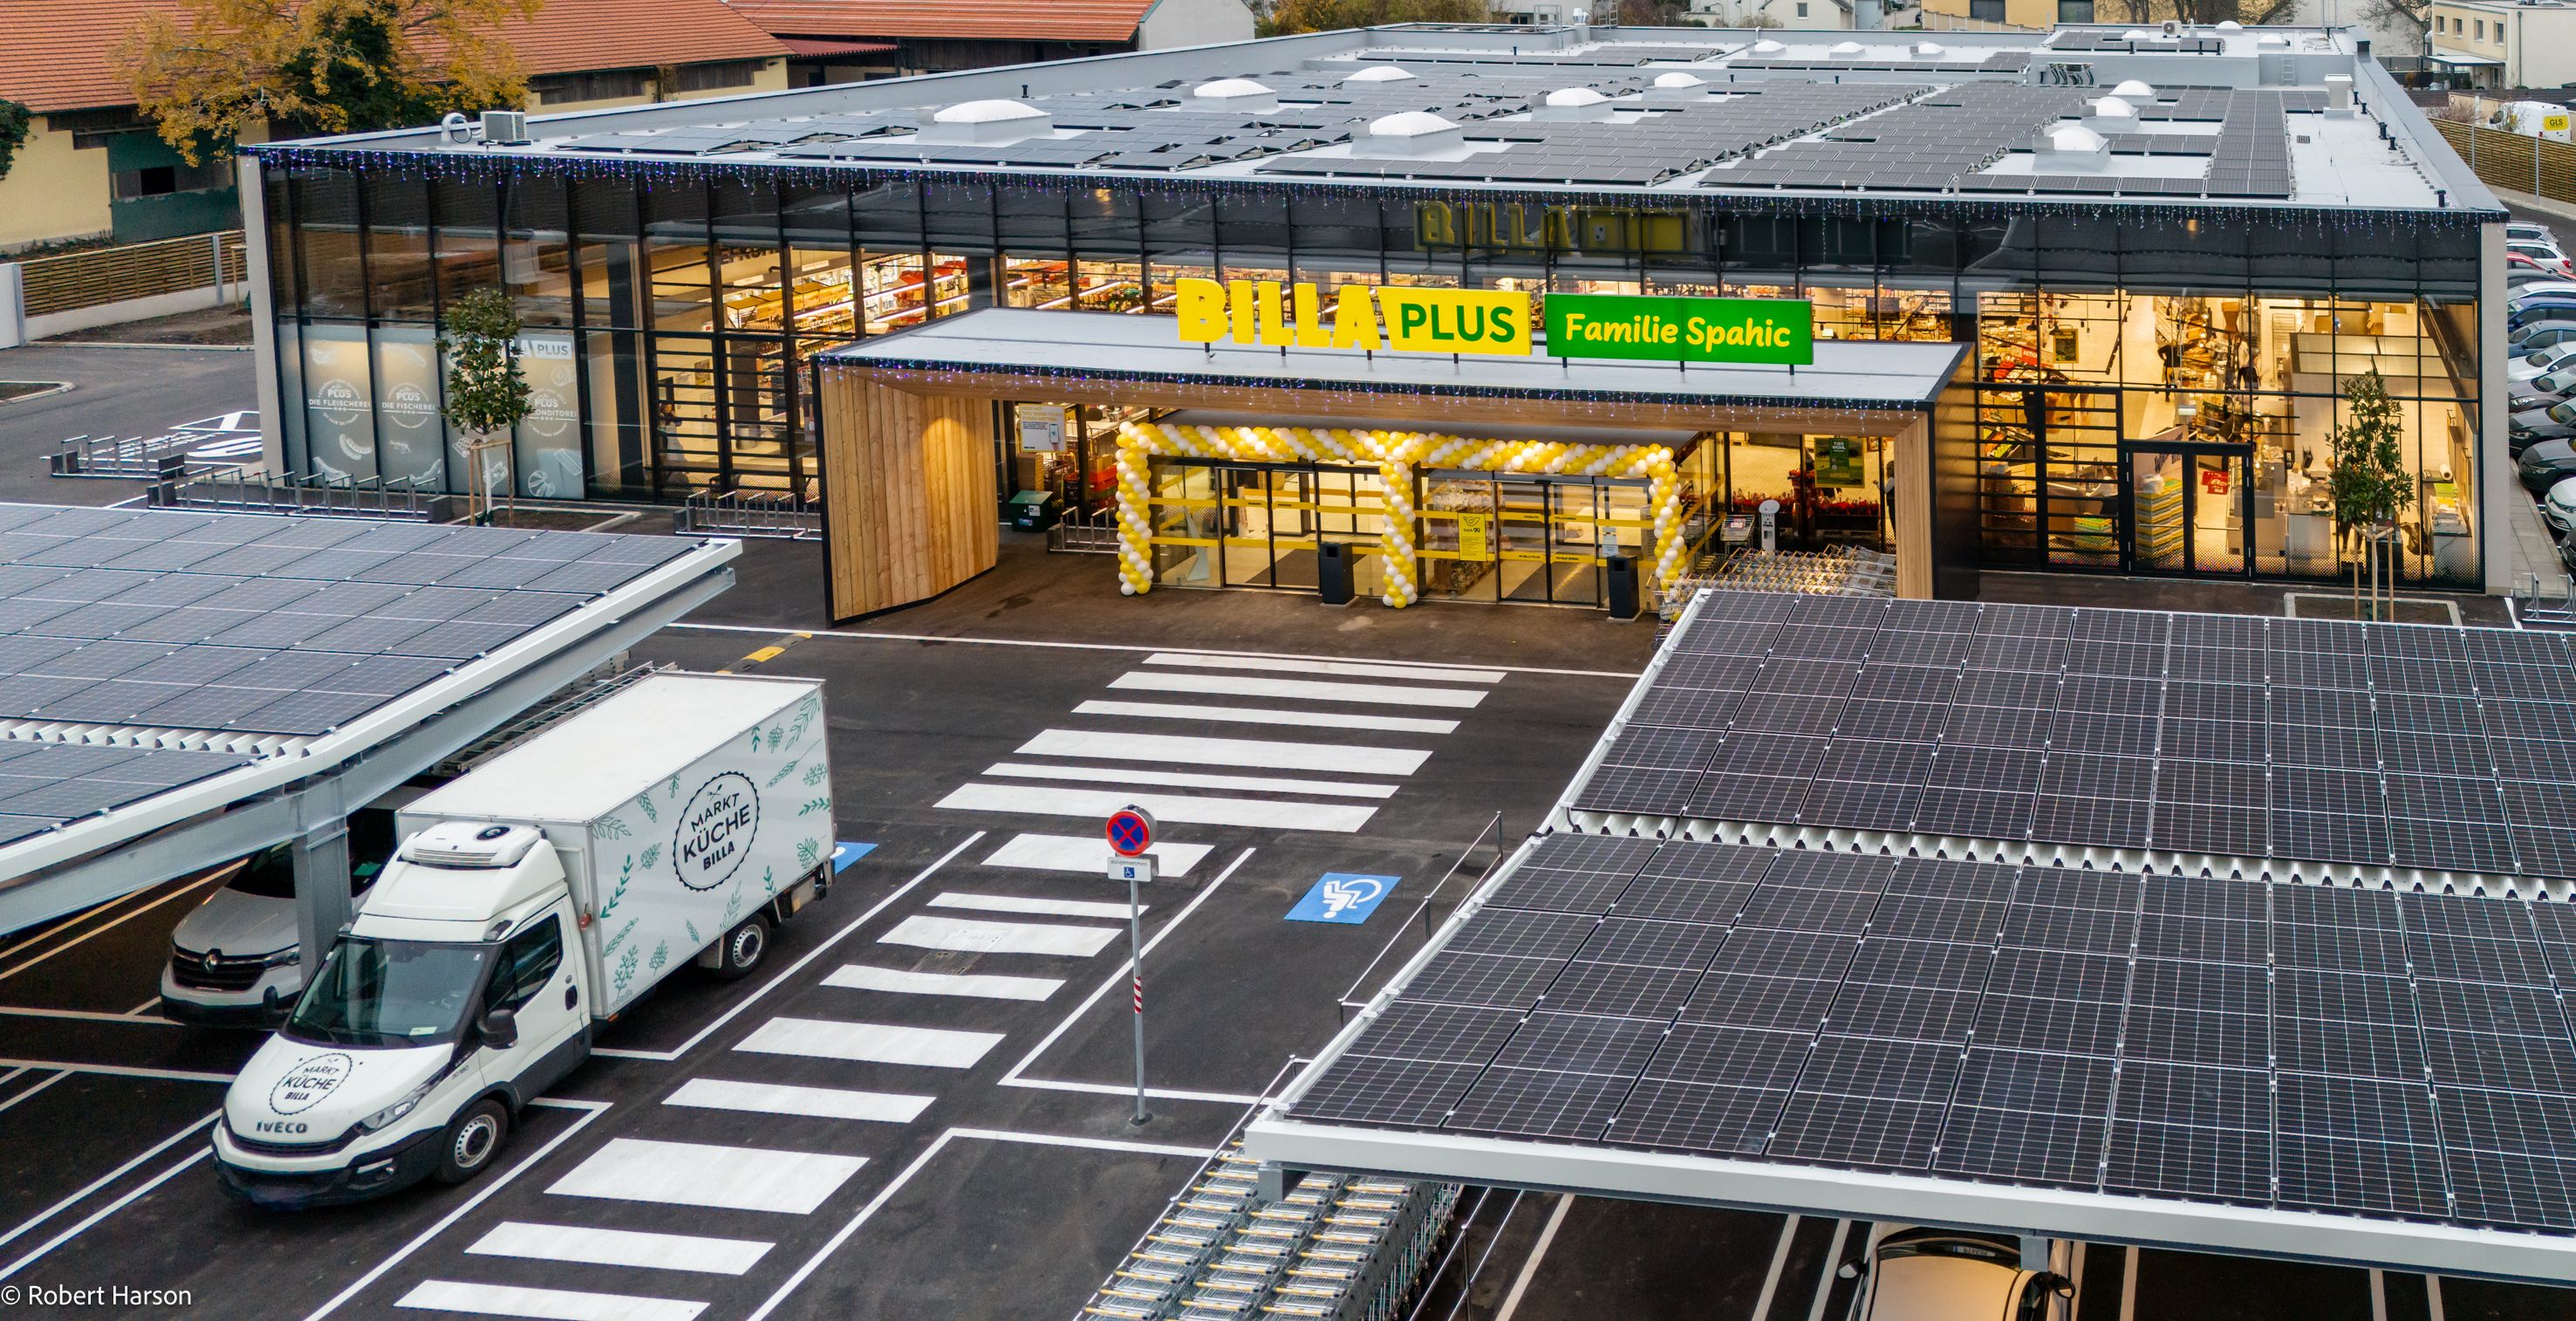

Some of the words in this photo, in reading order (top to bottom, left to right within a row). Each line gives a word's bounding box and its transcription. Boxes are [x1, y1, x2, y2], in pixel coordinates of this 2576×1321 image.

[1175, 277, 1382, 351] BILLA
[1400, 302, 1516, 343] PLUS
[1565, 312, 1678, 344] Familie
[1685, 316, 1791, 352] Spahic
[536, 344, 569, 356] PLUS
[327, 389, 352, 398] PLUS
[396, 392, 420, 401] PLUS
[323, 400, 371, 408] FLEISCHEREI
[534, 398, 559, 408] PLUS
[690, 792, 740, 832] MARKT
[682, 803, 751, 863] KÜCHE
[702, 840, 735, 871] BILLA
[303, 1066, 339, 1075] MARKT
[283, 1075, 337, 1090] KÜCHE
[256, 1119, 308, 1133] IVECO
